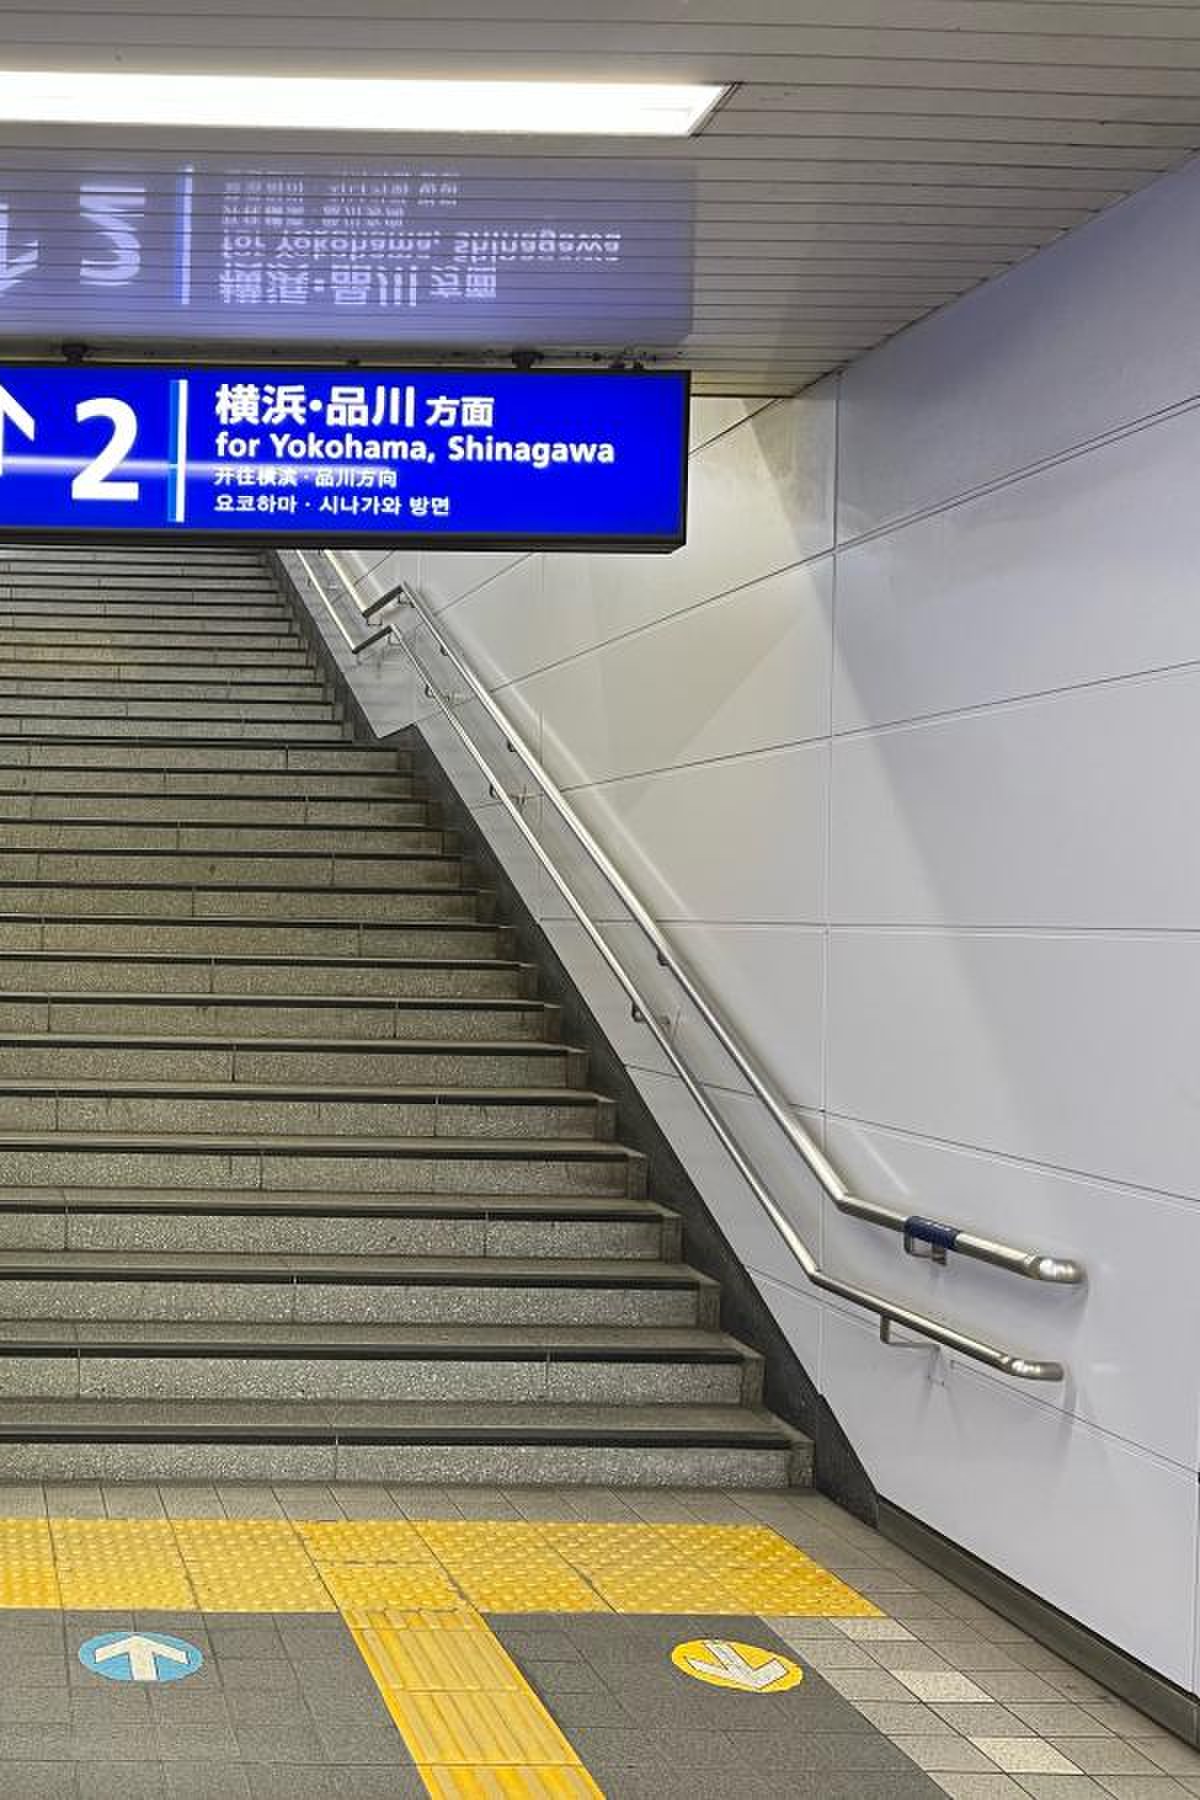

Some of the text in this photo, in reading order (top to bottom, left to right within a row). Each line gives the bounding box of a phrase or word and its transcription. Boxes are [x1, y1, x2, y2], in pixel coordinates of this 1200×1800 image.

[425, 396, 495, 427] 方面
[71, 397, 140, 501] 2
[215, 431, 615, 469] for Yokohama, Shinagawa
